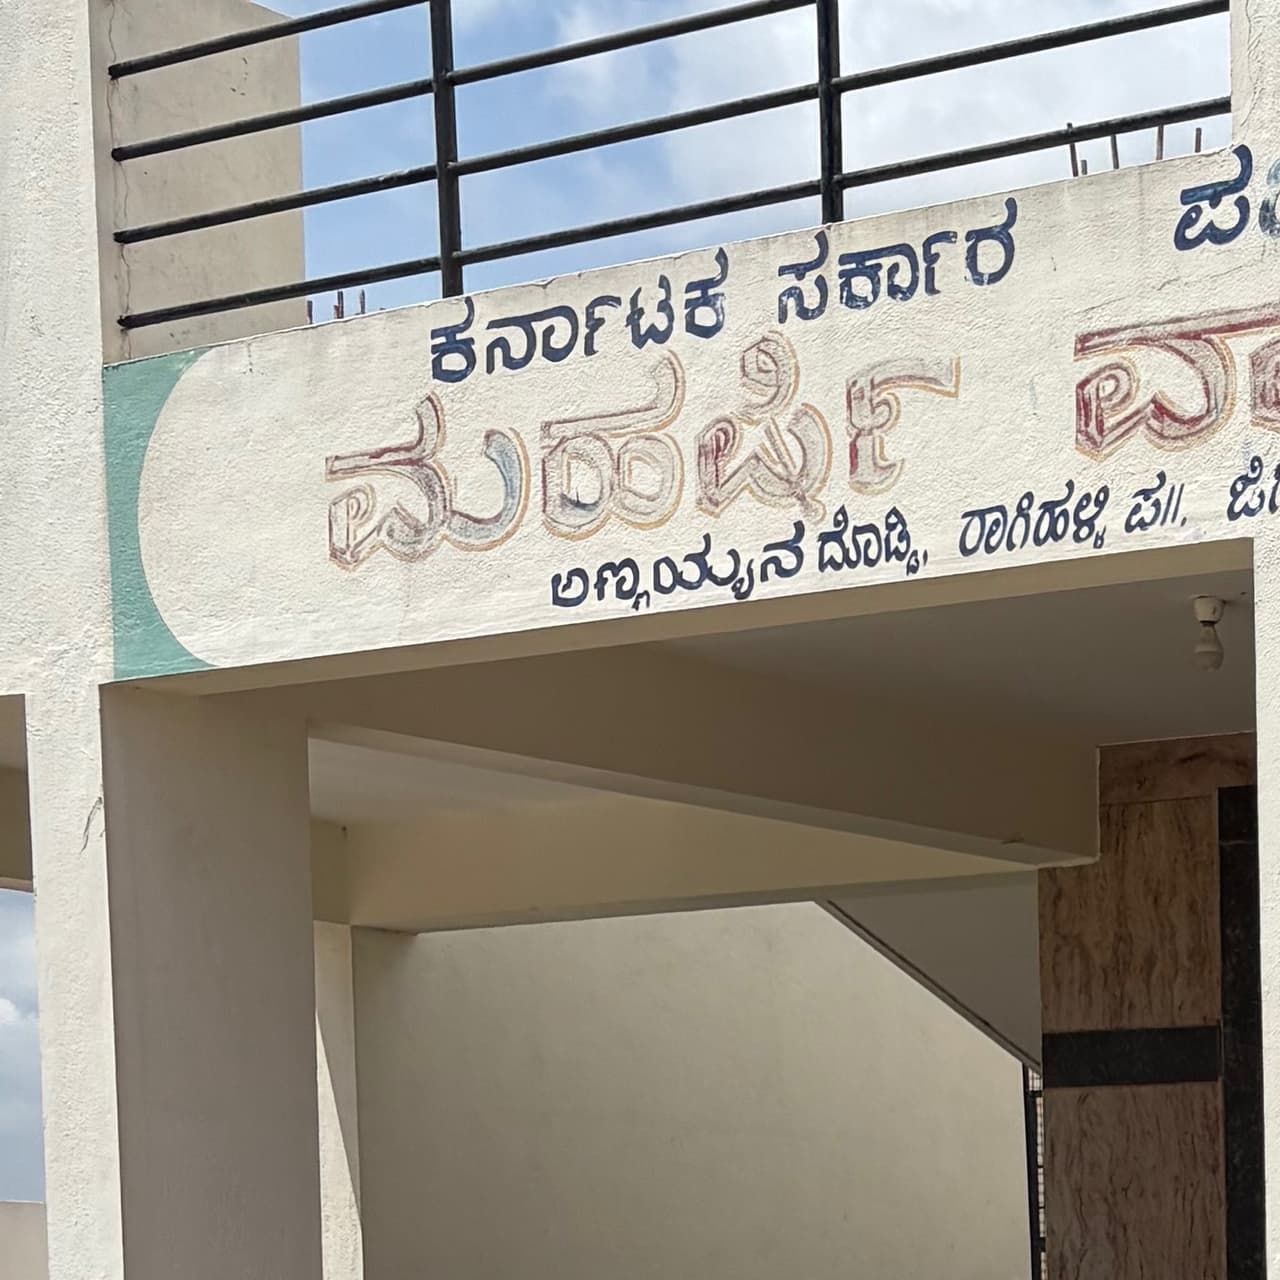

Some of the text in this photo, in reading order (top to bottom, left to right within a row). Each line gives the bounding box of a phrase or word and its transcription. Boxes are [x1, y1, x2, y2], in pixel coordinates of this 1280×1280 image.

[430, 245, 729, 384] ಕರ್ನಾಟಕ
[777, 197, 1018, 324] ಸರ್ಕಾರ
[323, 330, 962, 572] ಮಹರ್ಷಿ
